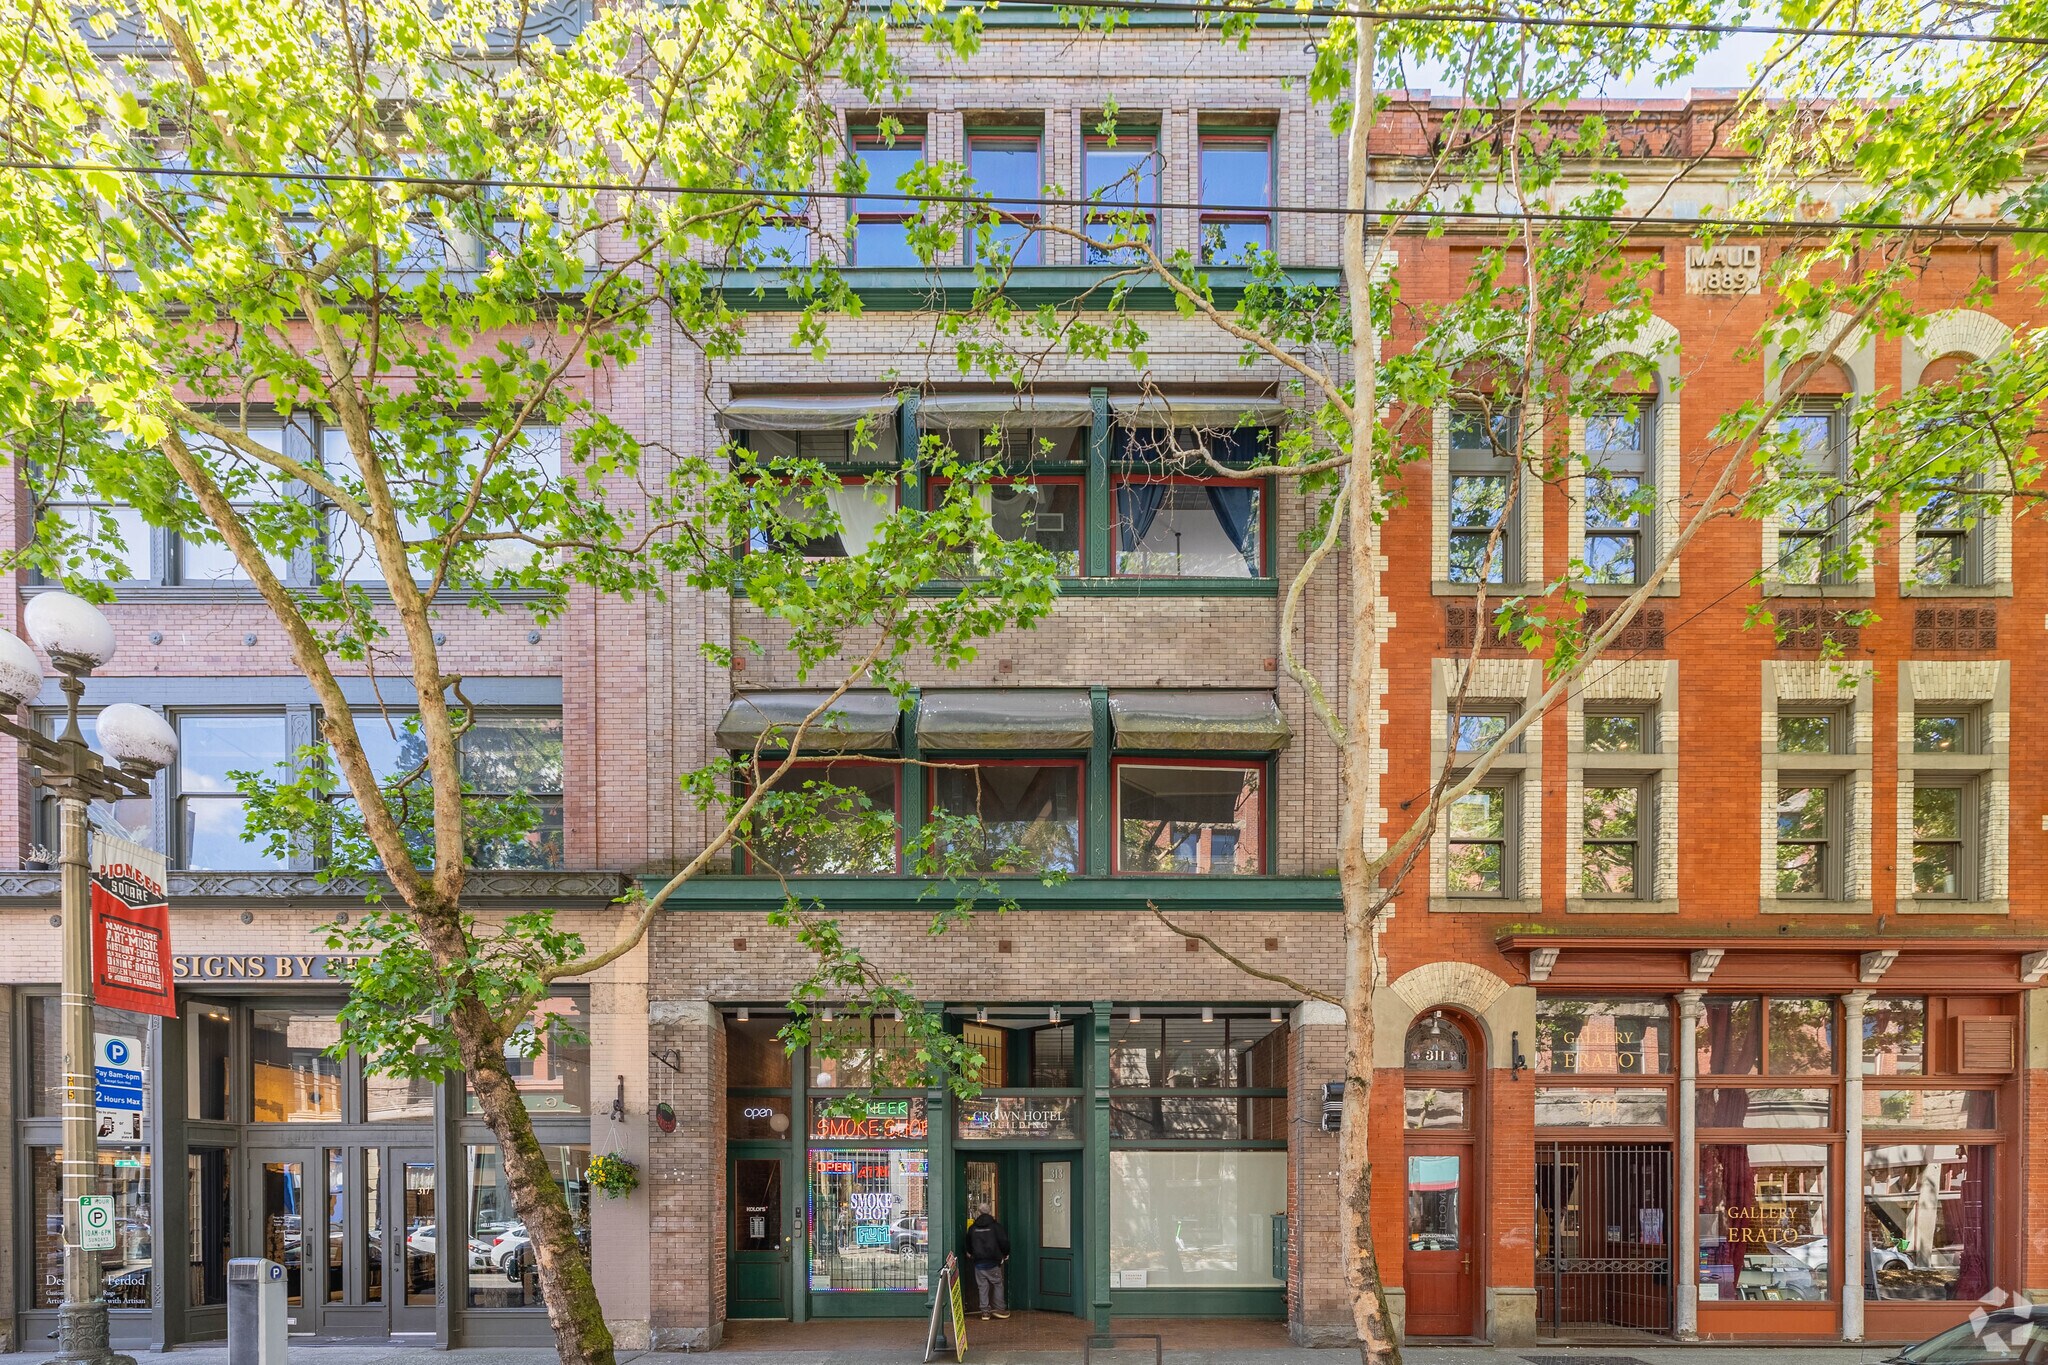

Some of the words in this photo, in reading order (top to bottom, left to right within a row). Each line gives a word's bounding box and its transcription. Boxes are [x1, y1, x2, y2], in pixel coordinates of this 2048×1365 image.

[1690, 247, 1756, 268] MAUD
[99, 863, 163, 899] PIONEER
[111, 880, 149, 902] SQUARE
[173, 956, 266, 978] SIGNS
[275, 956, 315, 978] BY
[1564, 1031, 1633, 1044] GALLERY
[1425, 1050, 1444, 1060] 311
[1564, 1052, 1634, 1068] ERATO
[108, 1070, 140, 1081] 8am-6pm
[96, 1091, 102, 1102] 2
[104, 1095, 125, 1104] Hours
[126, 1097, 140, 1105] Max
[744, 1108, 773, 1120] open
[1580, 1099, 1617, 1117] 309
[973, 1110, 1021, 1121] CROWN
[1024, 1110, 1065, 1121] HOTEL
[817, 1119, 879, 1137] SMOKE
[990, 1121, 1048, 1129] BUILDING
[816, 1162, 852, 1172] OPEN
[1051, 1168, 1063, 1179] 313
[417, 1187, 430, 1195] 317
[850, 1193, 892, 1209] SMOKE
[855, 1207, 889, 1220] SHOP
[1727, 1206, 1797, 1219] GALLERY
[1728, 1227, 1798, 1243] ERATO
[108, 1274, 146, 1286] Ferdod
